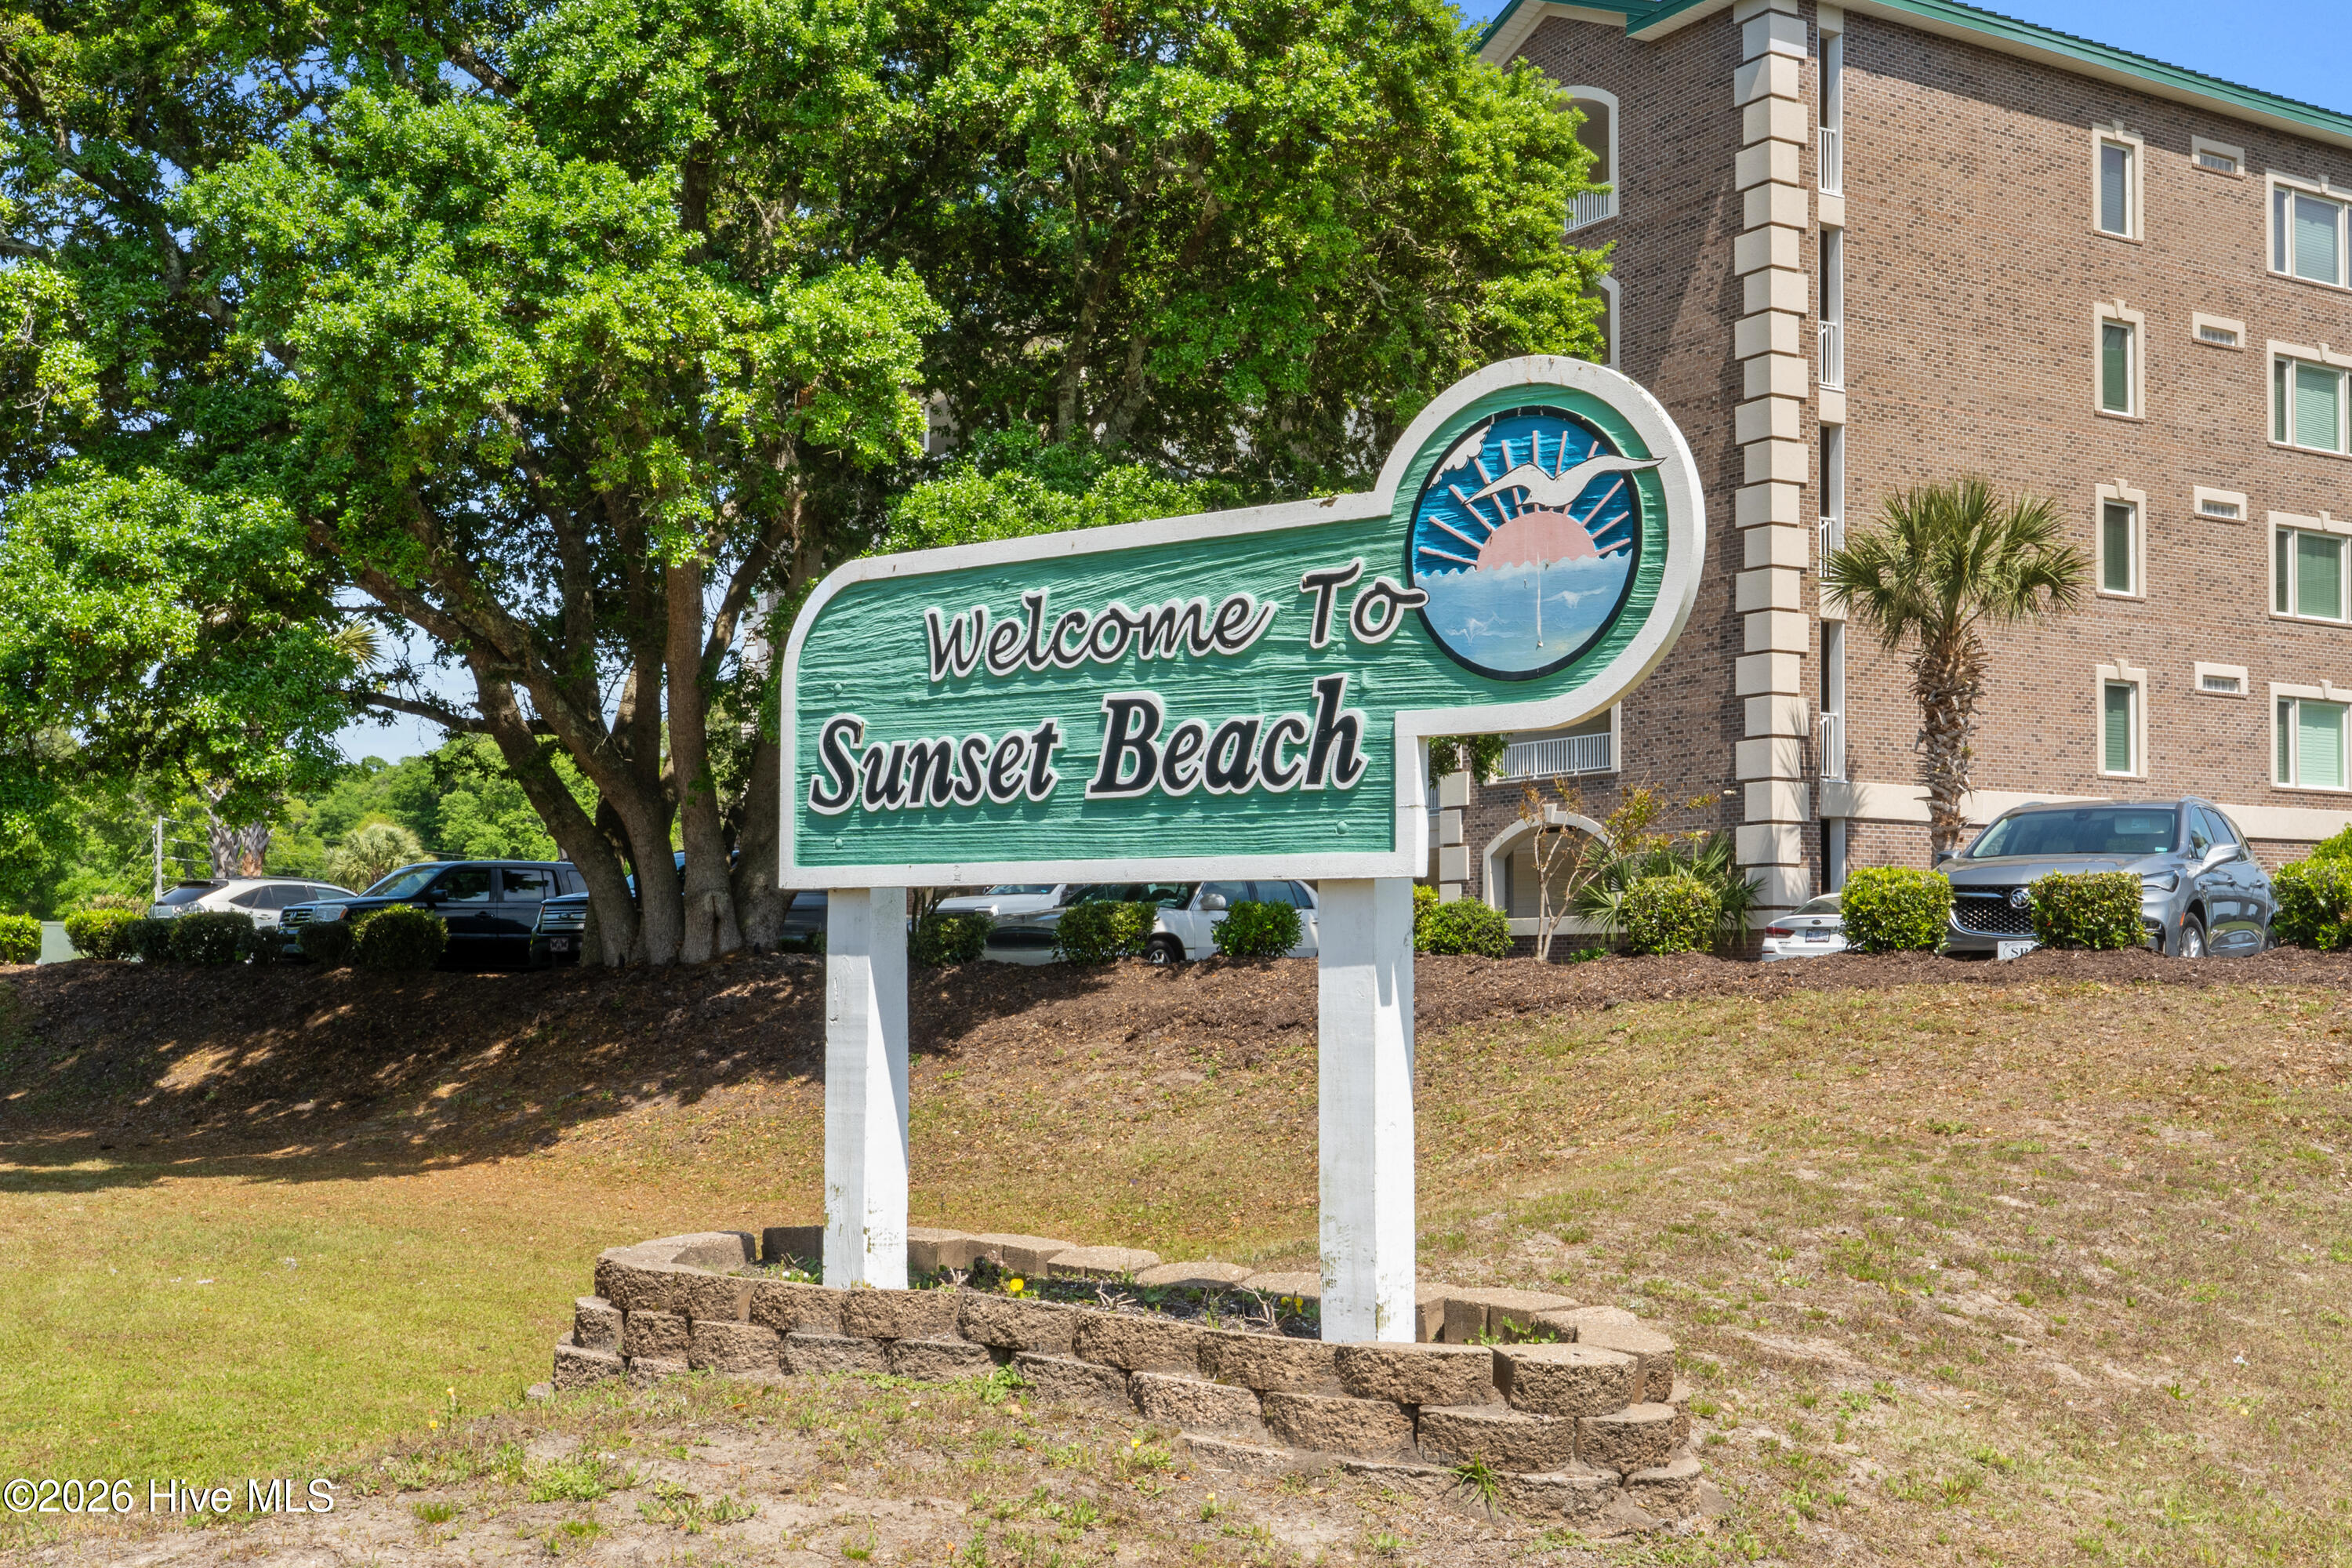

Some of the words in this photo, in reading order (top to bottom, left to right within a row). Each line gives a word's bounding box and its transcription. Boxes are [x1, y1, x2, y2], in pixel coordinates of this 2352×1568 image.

[925, 588, 1278, 681] Welcome
[1300, 557, 1429, 648] To
[808, 713, 1062, 815] Sunset
[1086, 673, 1370, 799] Beach
